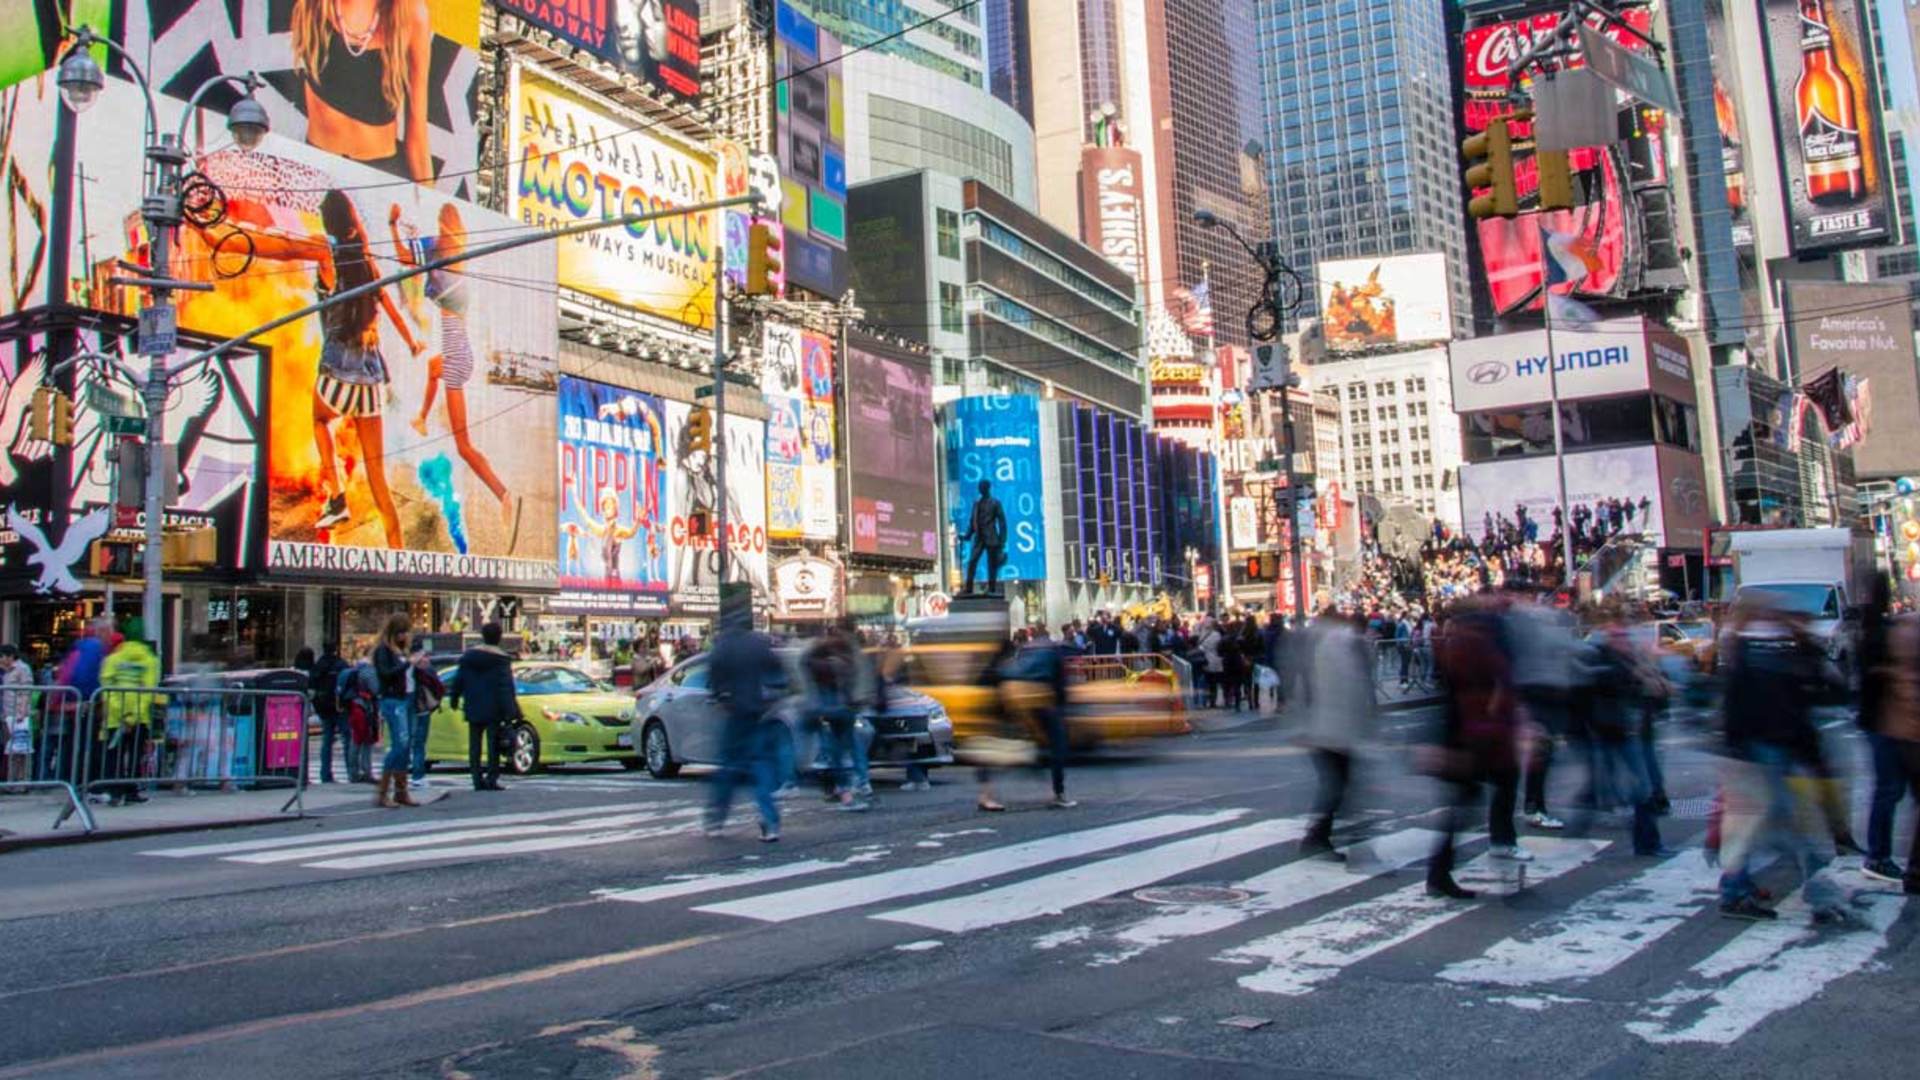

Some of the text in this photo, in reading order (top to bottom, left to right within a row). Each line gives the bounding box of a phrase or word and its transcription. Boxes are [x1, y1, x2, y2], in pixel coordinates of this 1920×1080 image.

[508, 0, 606, 48] OADWAY
[518, 142, 709, 262] MOTOWN
[643, 250, 708, 286] MUSICAL
[1810, 334, 1866, 350] Favorite
[1820, 317, 1886, 332] America's
[1516, 345, 1630, 377] HYUNDAI
[561, 443, 660, 523] PIPPIN
[671, 514, 765, 555] CCAGO
[267, 542, 560, 581] AMERICAN EAGLE OUTFITTERS
